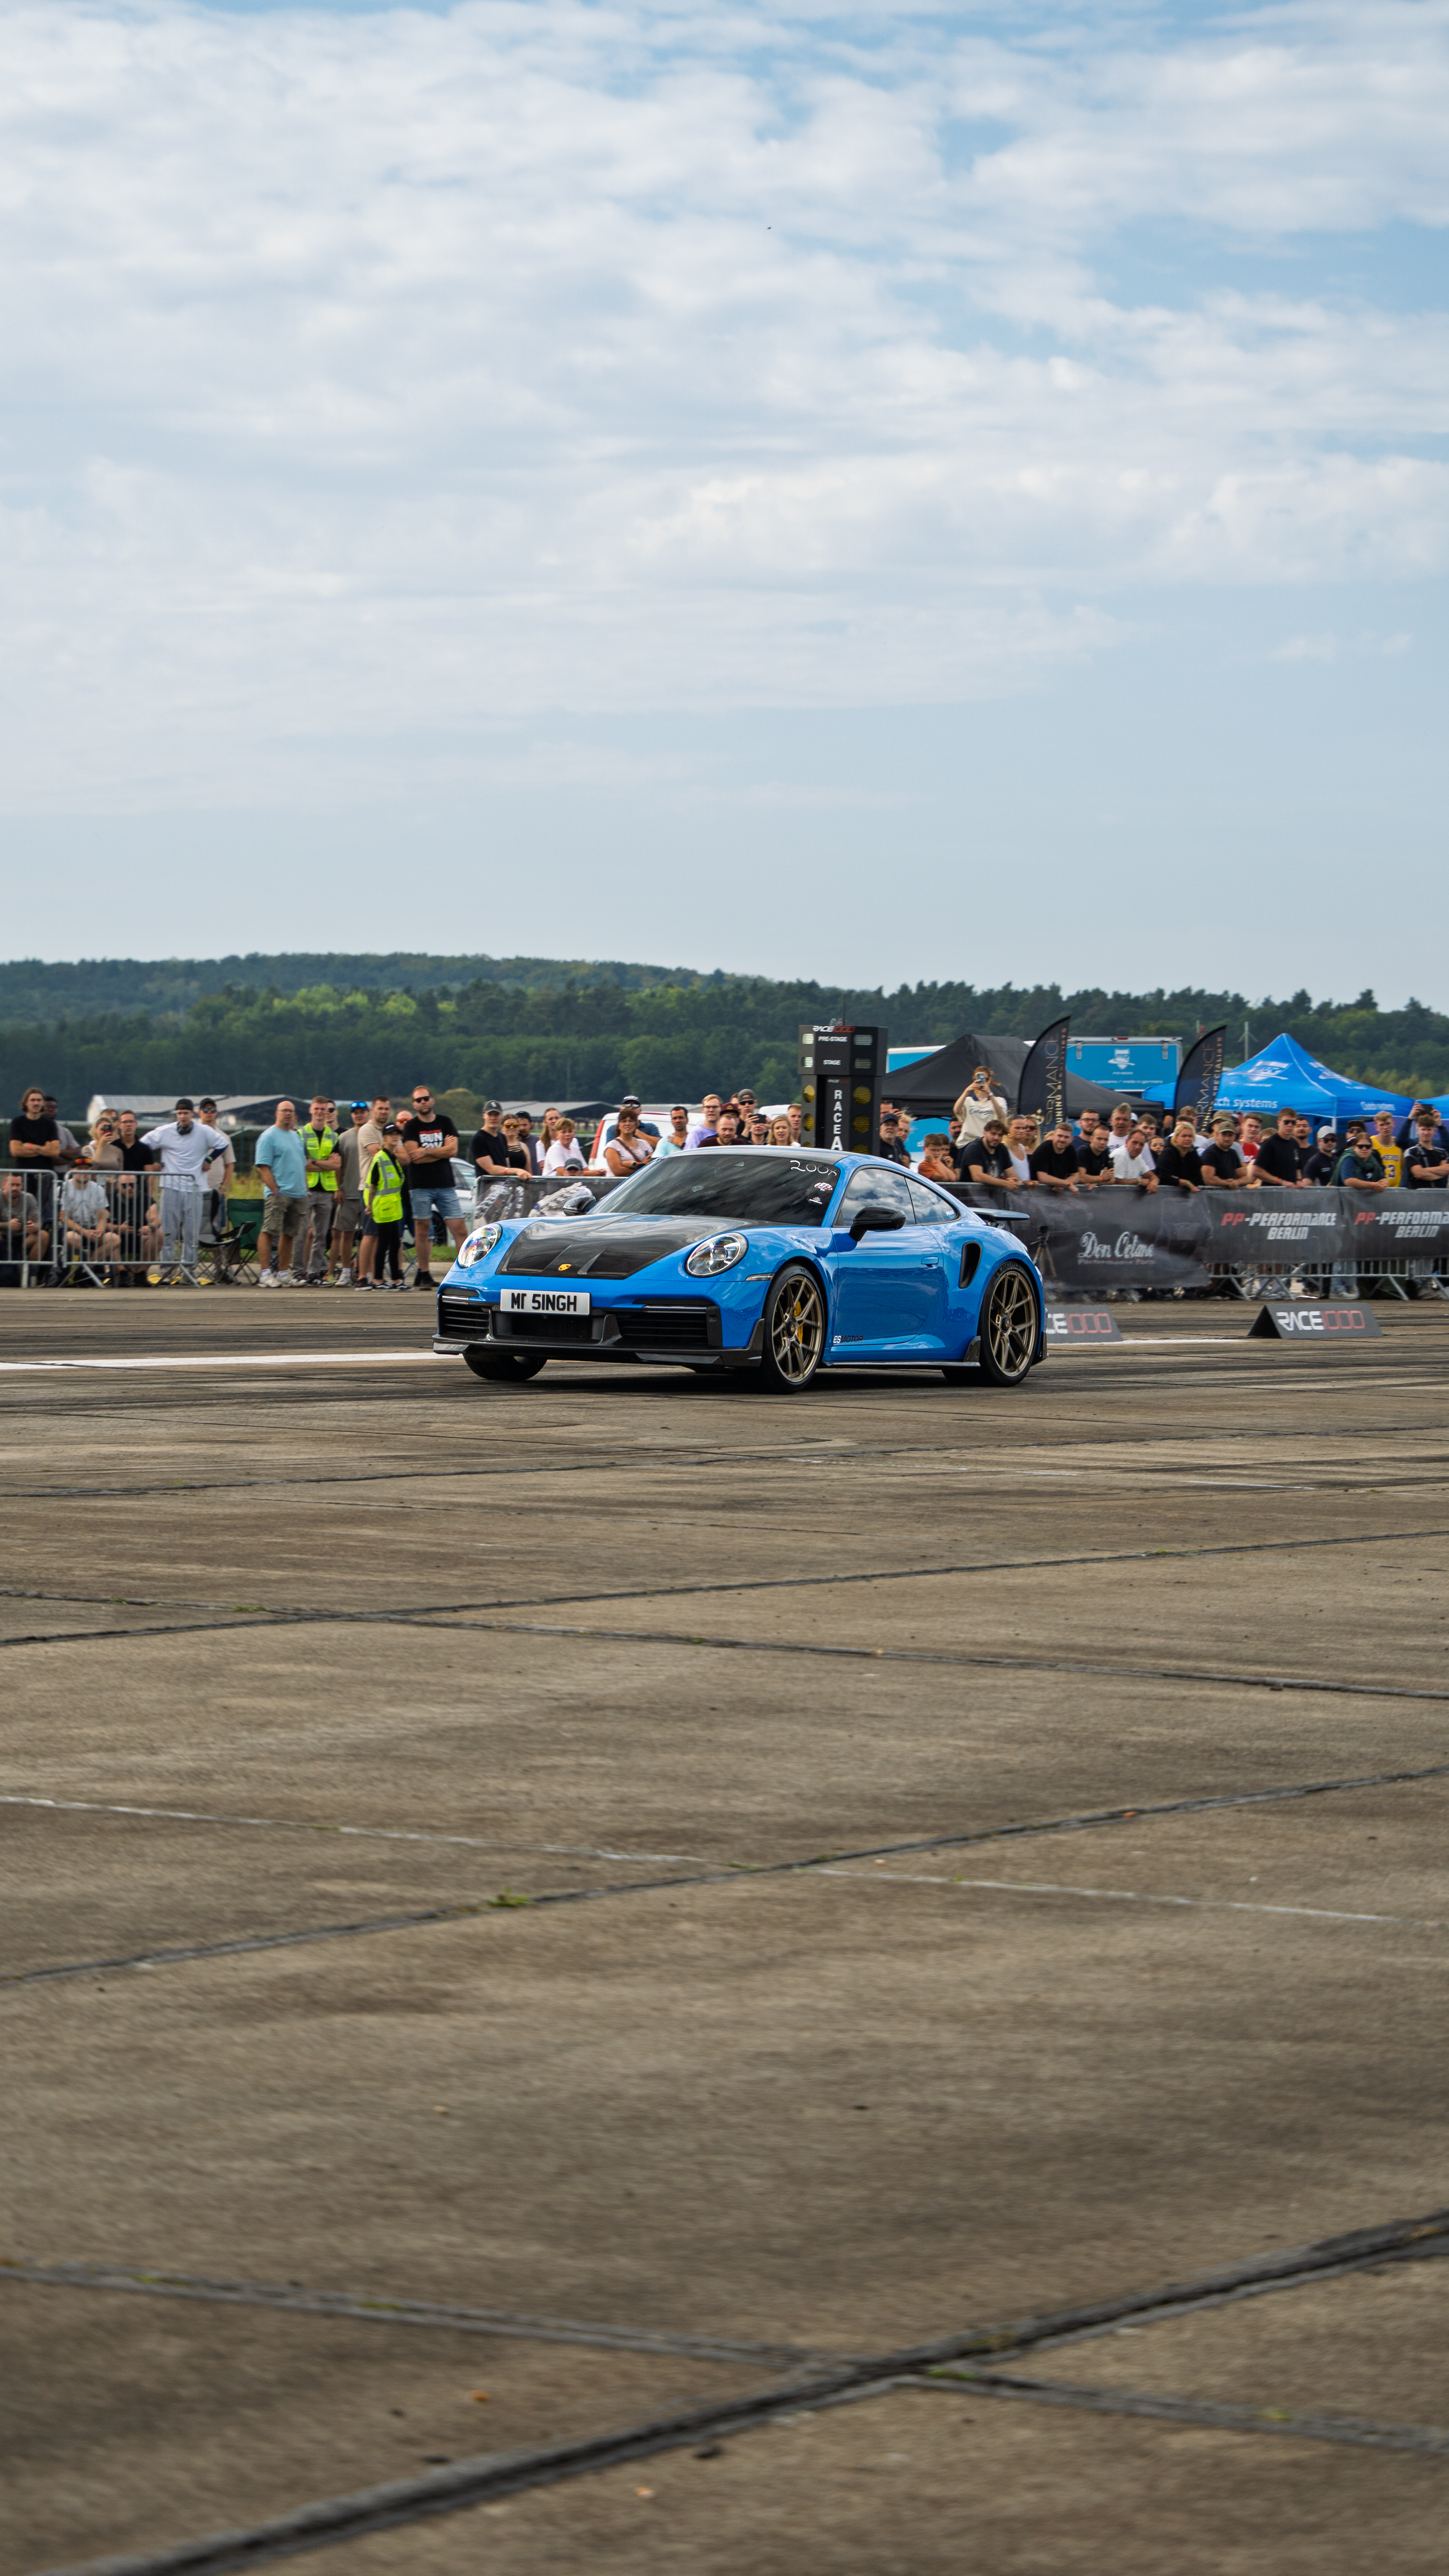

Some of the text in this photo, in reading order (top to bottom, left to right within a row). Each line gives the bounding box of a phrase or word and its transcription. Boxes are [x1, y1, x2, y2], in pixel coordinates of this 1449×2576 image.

[1233, 1098, 1278, 1109] systems
[419, 1132, 443, 1143] RUN
[1267, 1227, 1310, 1240] BERLIN
[1394, 1225, 1440, 1238] BERLIN
[1077, 1231, 1112, 1258] Don
